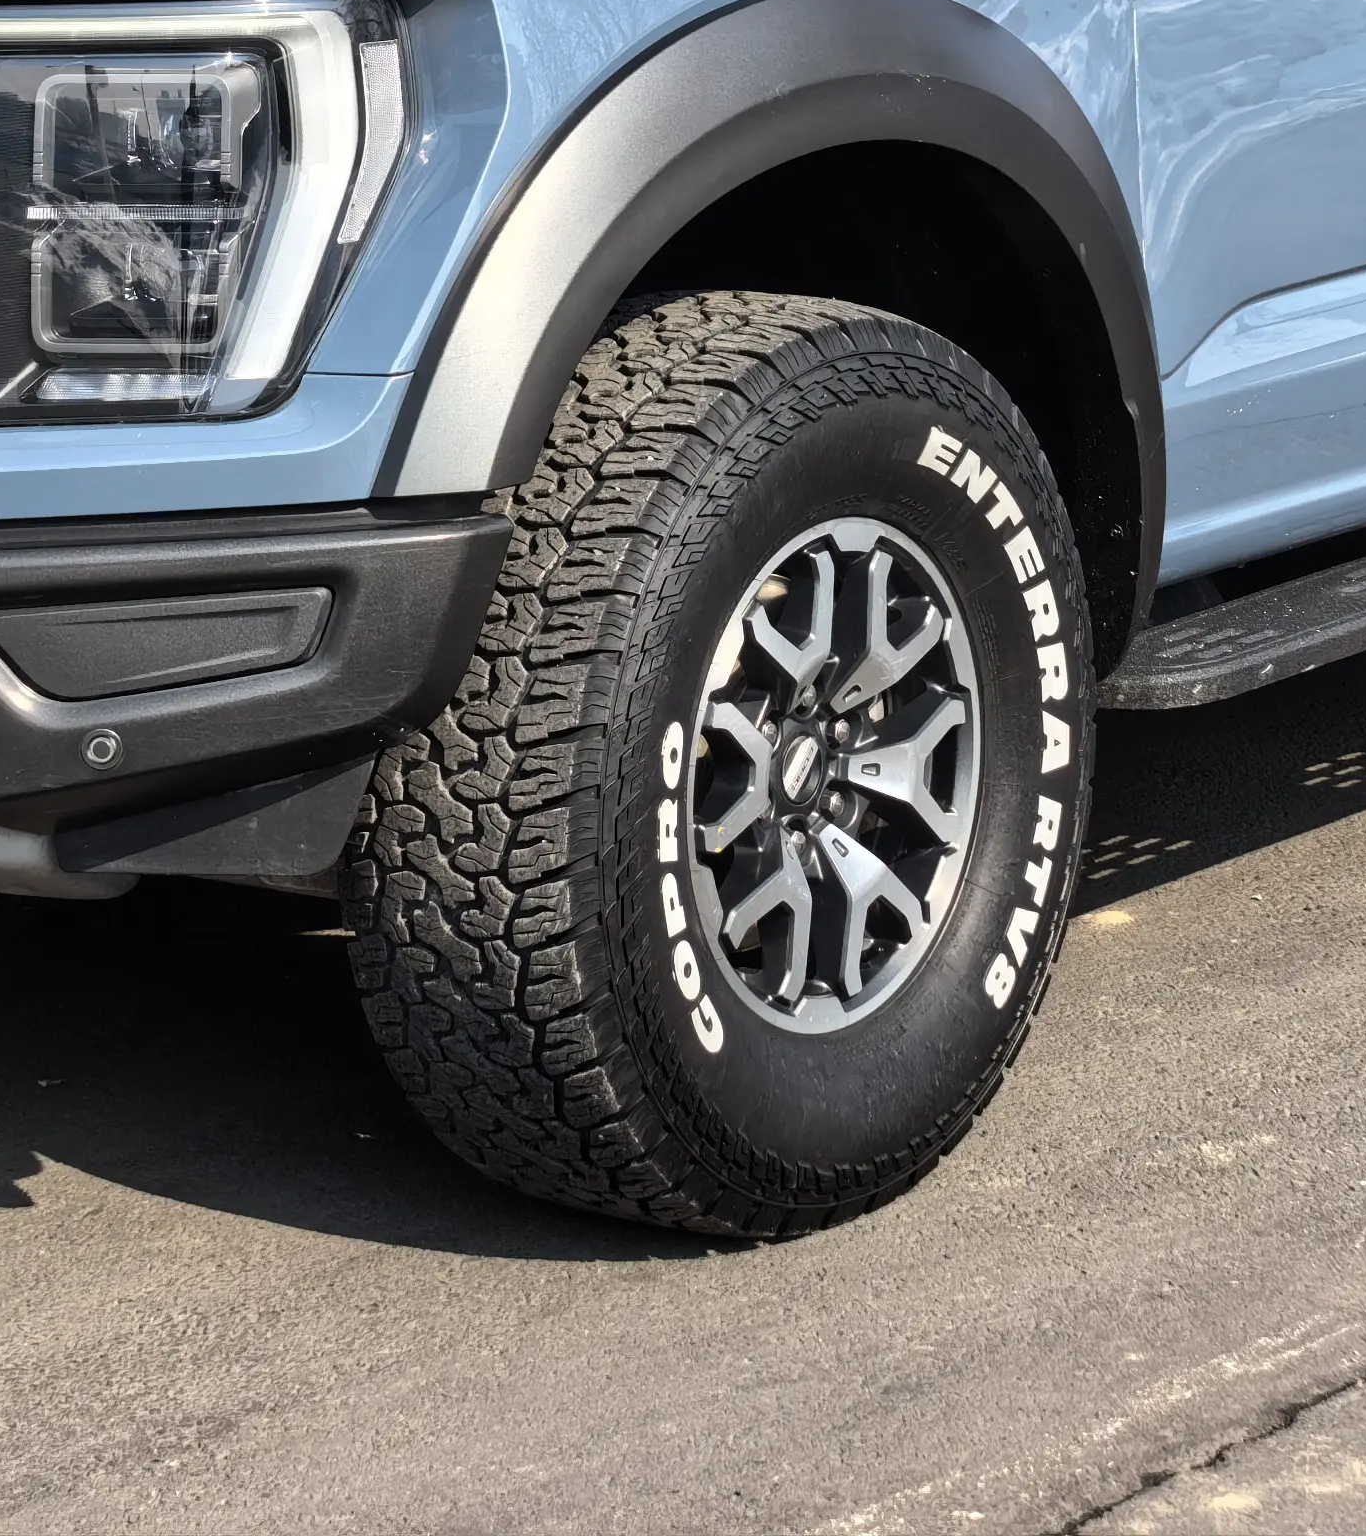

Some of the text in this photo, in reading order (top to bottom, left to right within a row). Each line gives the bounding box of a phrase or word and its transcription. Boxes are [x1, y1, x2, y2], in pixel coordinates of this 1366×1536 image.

[657, 721, 724, 1053] GOPRO
[917, 425, 1070, 1009] ENTERRA RTV8
